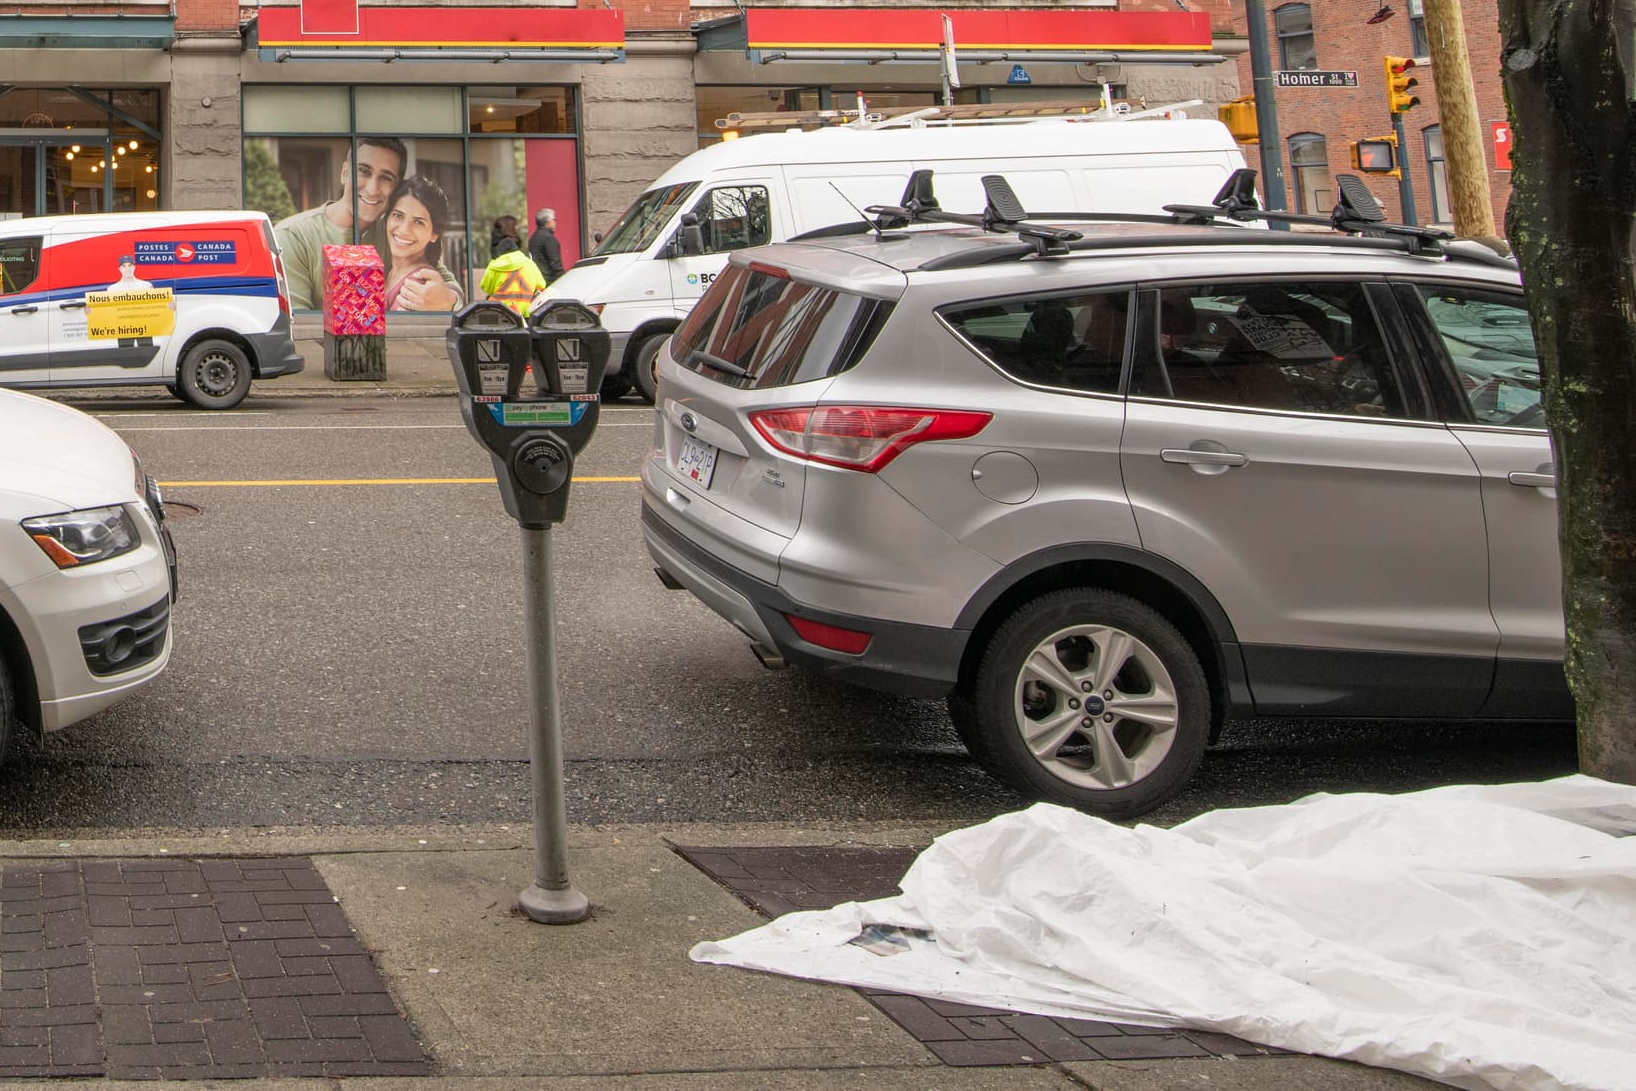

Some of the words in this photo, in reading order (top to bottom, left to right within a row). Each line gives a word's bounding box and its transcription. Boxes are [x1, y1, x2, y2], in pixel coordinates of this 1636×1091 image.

[1281, 72, 1325, 86] Homer
[197, 243, 232, 251] CANADA
[89, 295, 111, 303] Nous
[113, 291, 170, 302] embauchons!
[91, 327, 116, 336] We're
[118, 325, 147, 335] hiring!
